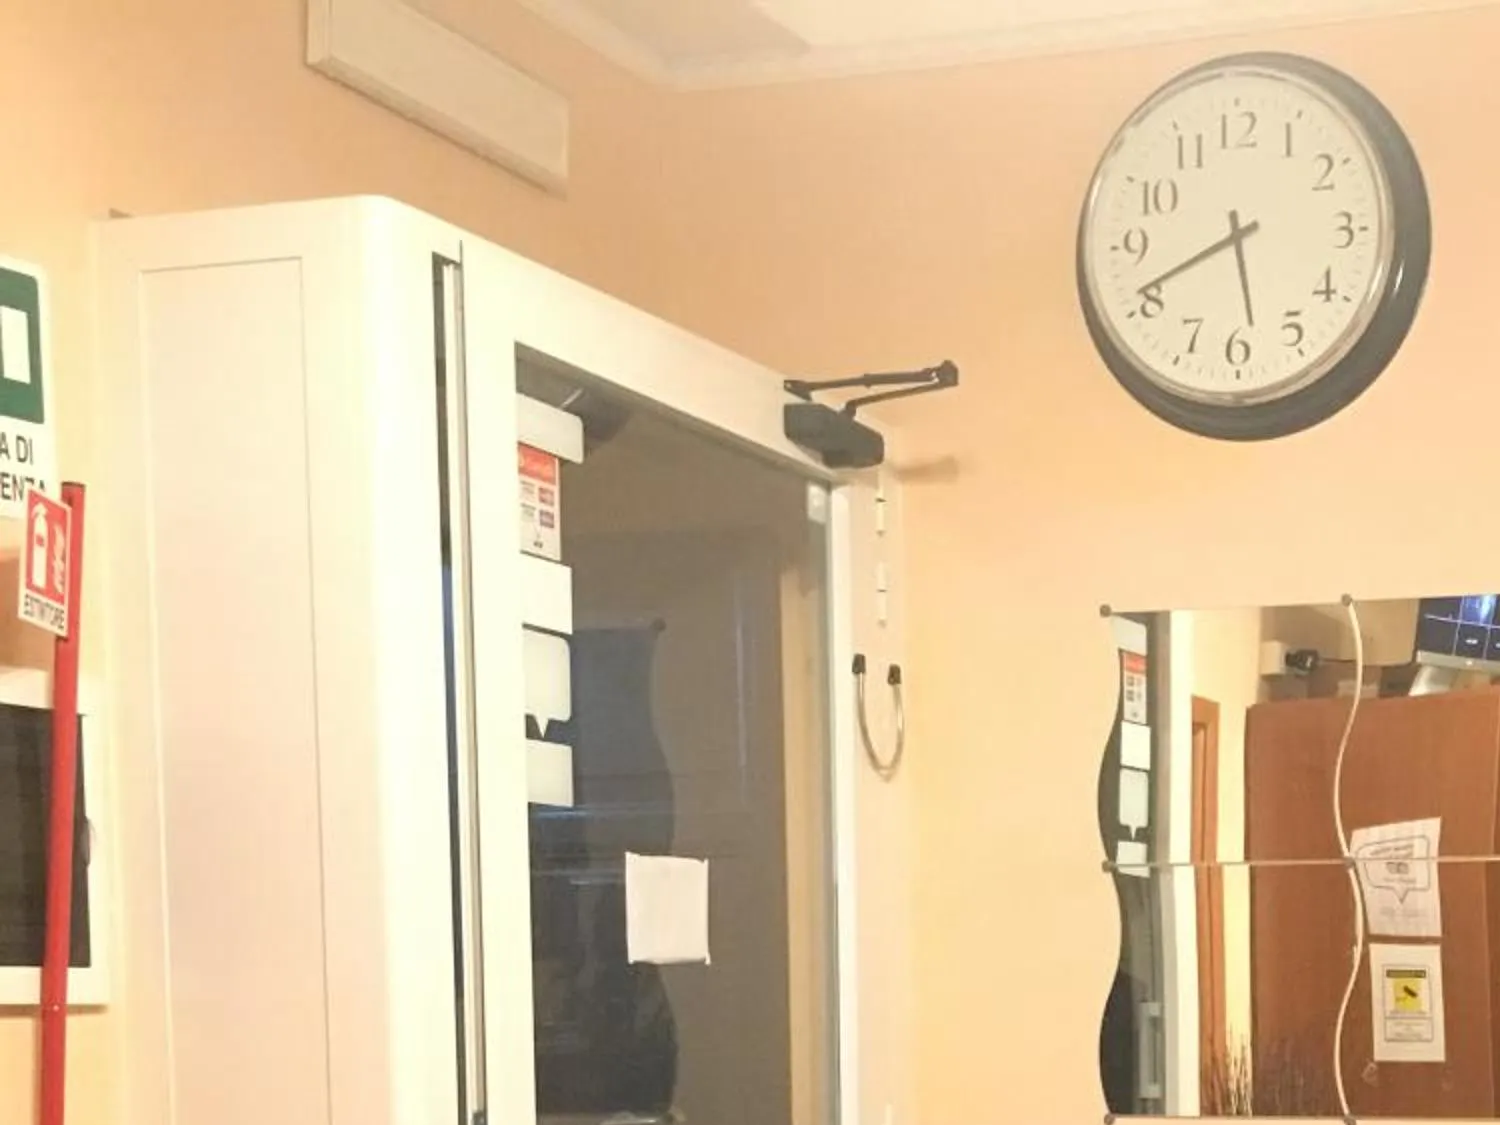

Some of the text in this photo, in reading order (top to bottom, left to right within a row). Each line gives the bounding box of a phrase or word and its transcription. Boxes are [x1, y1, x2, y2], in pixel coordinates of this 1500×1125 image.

[1219, 110, 1258, 150] 12
[1284, 121, 1293, 158] 1
[1177, 133, 1203, 169] 11
[1311, 152, 1336, 192] 2
[1141, 178, 1179, 216] 10
[1123, 226, 1149, 266] 9
[1333, 210, 1355, 249] 3
[1139, 284, 1165, 319] 8
[1311, 265, 1337, 302] 4
[1181, 316, 1205, 354] 7
[1224, 328, 1251, 366] 6
[1280, 309, 1305, 348] 5
[16, 433, 34, 466] DI
